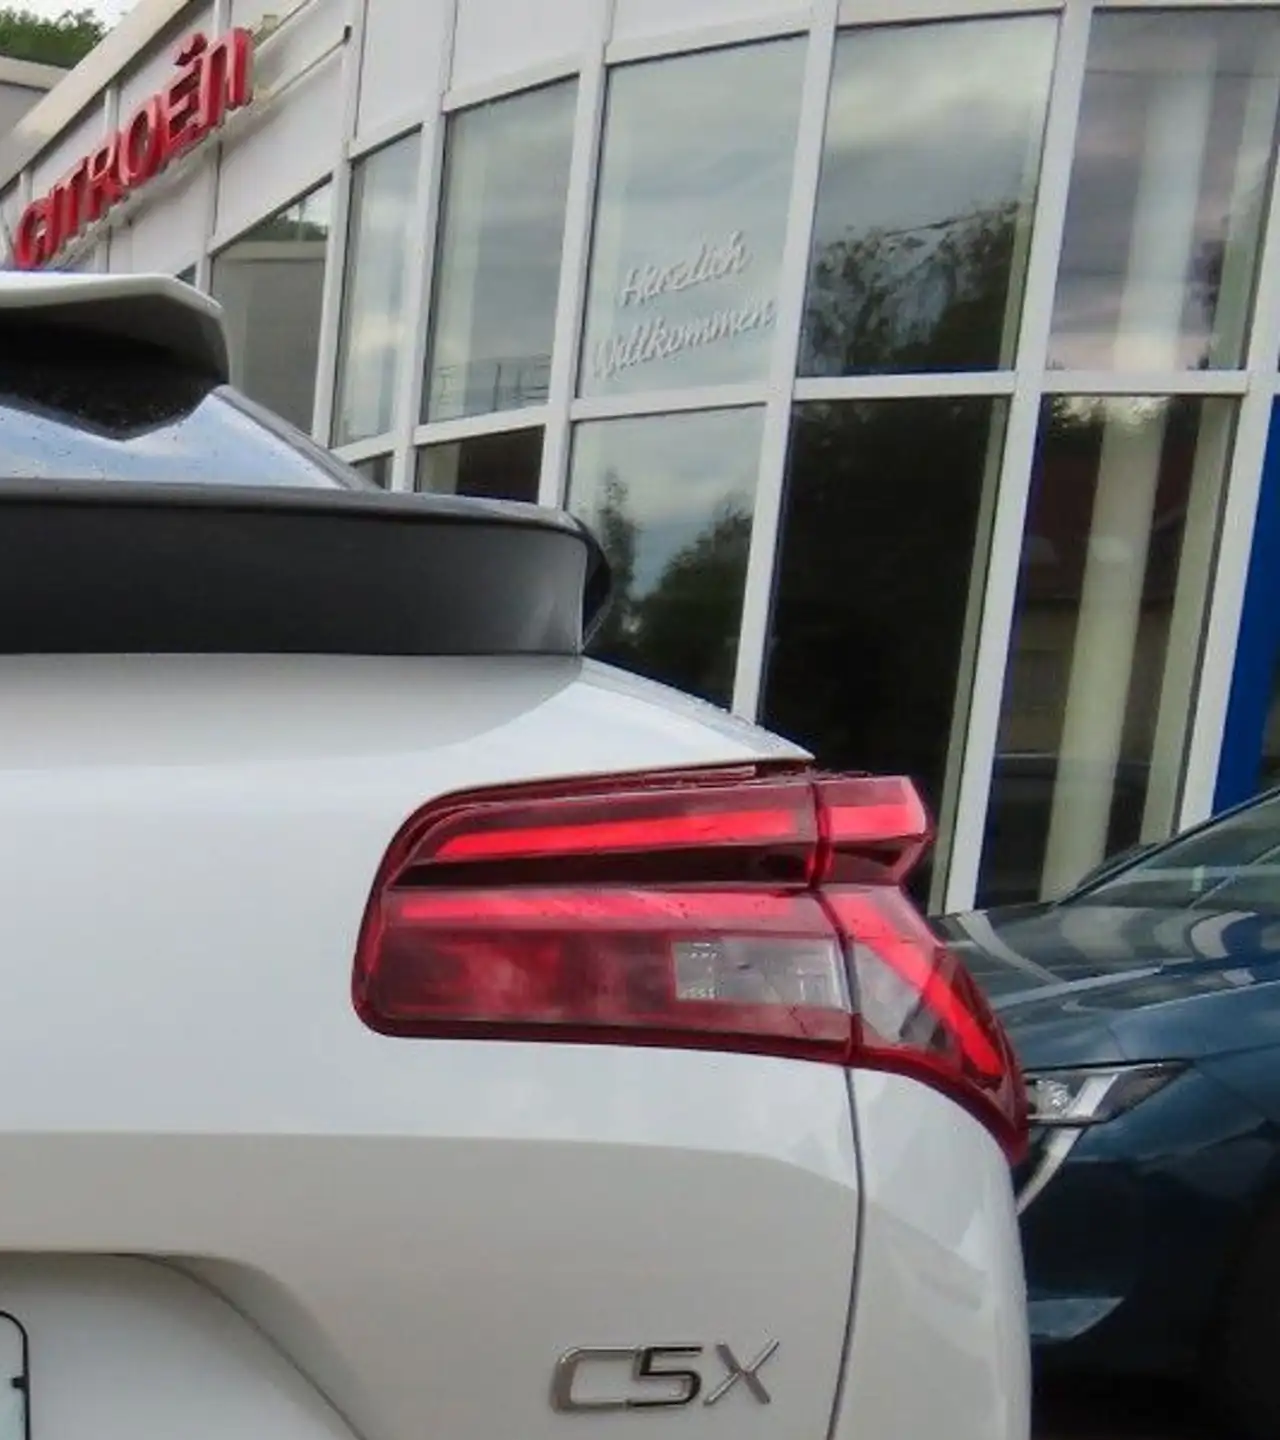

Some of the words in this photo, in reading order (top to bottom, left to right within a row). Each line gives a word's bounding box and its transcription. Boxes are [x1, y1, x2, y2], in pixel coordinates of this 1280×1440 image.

[621, 230, 754, 308] Herzlich
[593, 299, 778, 382] Willkommen
[548, 1337, 781, 1413] C5X
